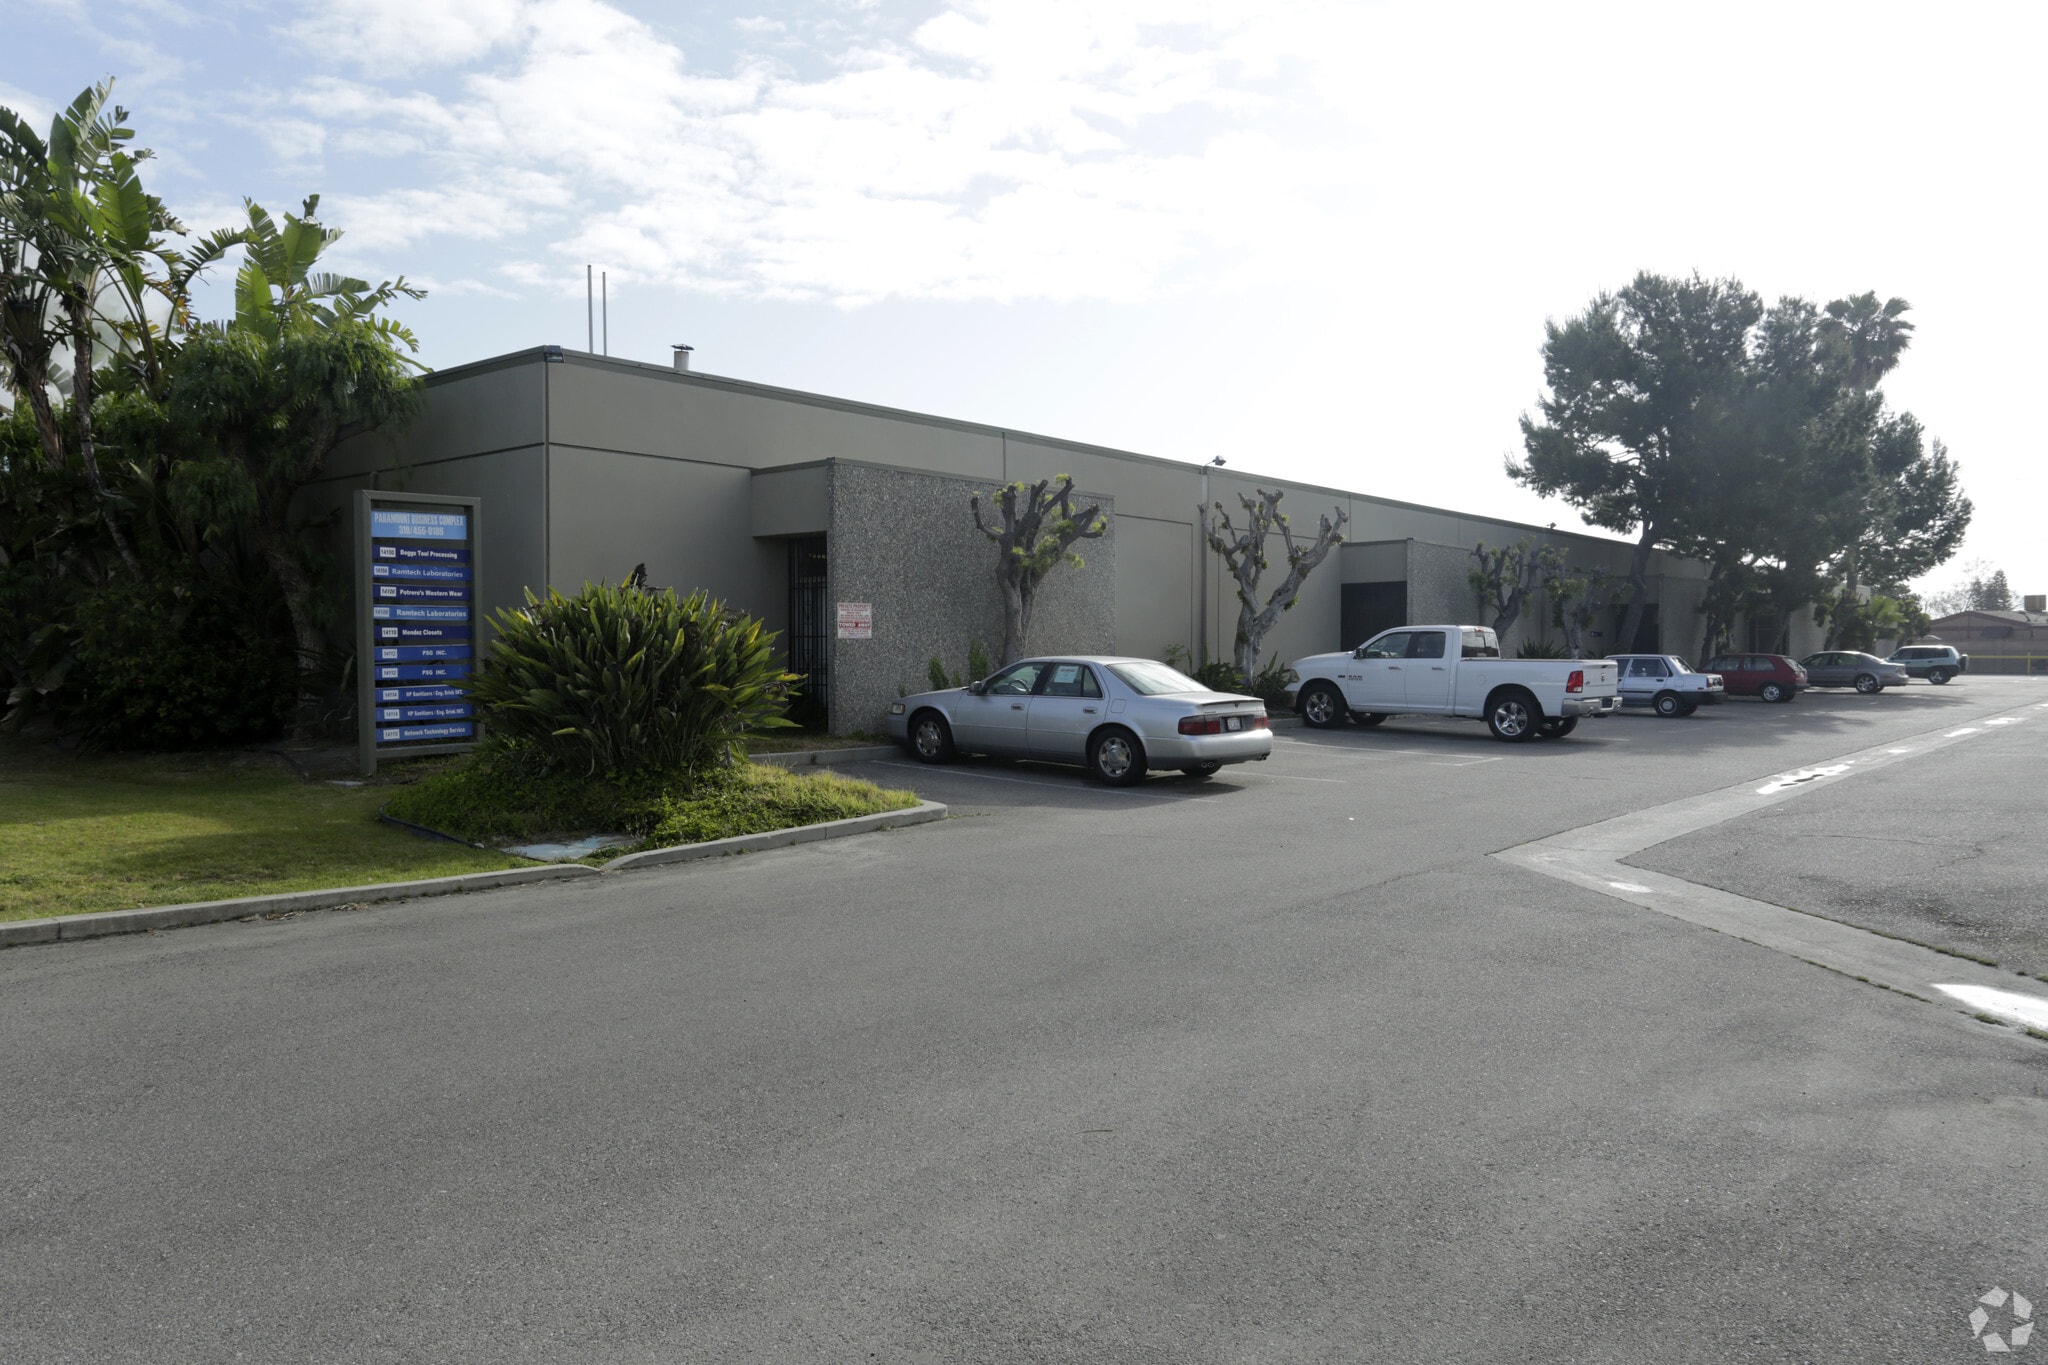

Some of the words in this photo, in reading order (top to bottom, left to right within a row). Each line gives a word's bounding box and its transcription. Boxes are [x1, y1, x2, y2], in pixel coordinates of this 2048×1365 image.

[374, 513, 411, 525] PARAMOUNT
[411, 514, 438, 525] BUSINESS
[439, 515, 464, 526] COMPLEX
[430, 551, 458, 560] Processing
[422, 568, 463, 578] Laboratories
[396, 608, 425, 616] Ramtech
[426, 609, 467, 618] Laboratories
